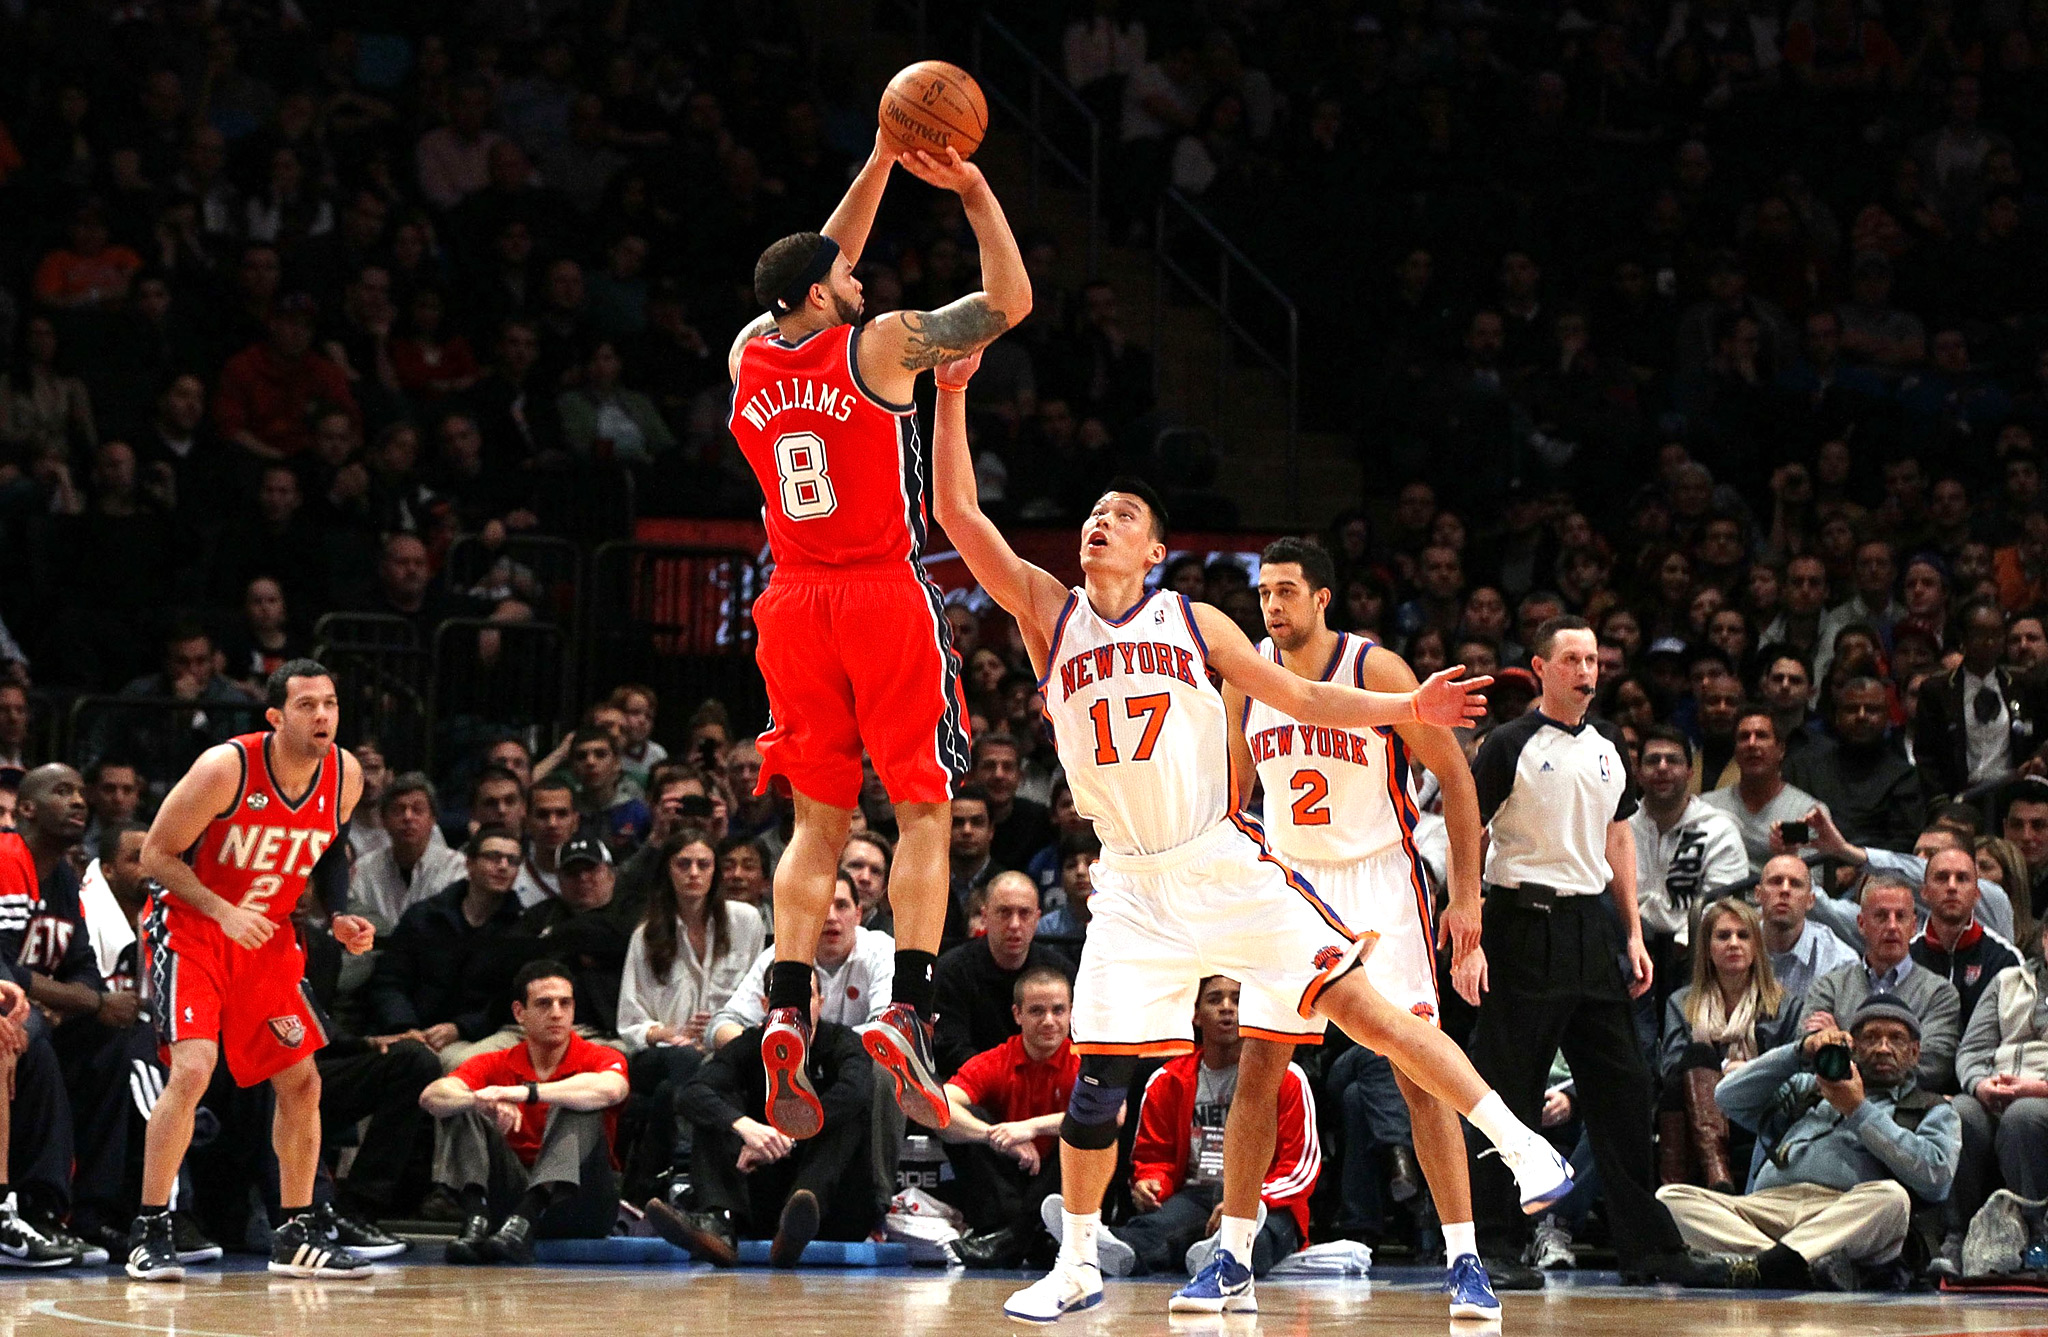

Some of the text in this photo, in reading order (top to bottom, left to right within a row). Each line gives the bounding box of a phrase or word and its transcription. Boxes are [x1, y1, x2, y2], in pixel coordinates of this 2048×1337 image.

[886, 99, 952, 149] SPALDING
[741, 377, 857, 432] WILLIAMS
[773, 430, 838, 522] 8
[1060, 641, 1198, 703] NEW YORK
[1089, 691, 1171, 766] 17
[1250, 724, 1369, 767] NEW YORK
[1289, 768, 1331, 826] 2
[238, 873, 284, 913] 2
[1193, 1102, 1230, 1129] NE
